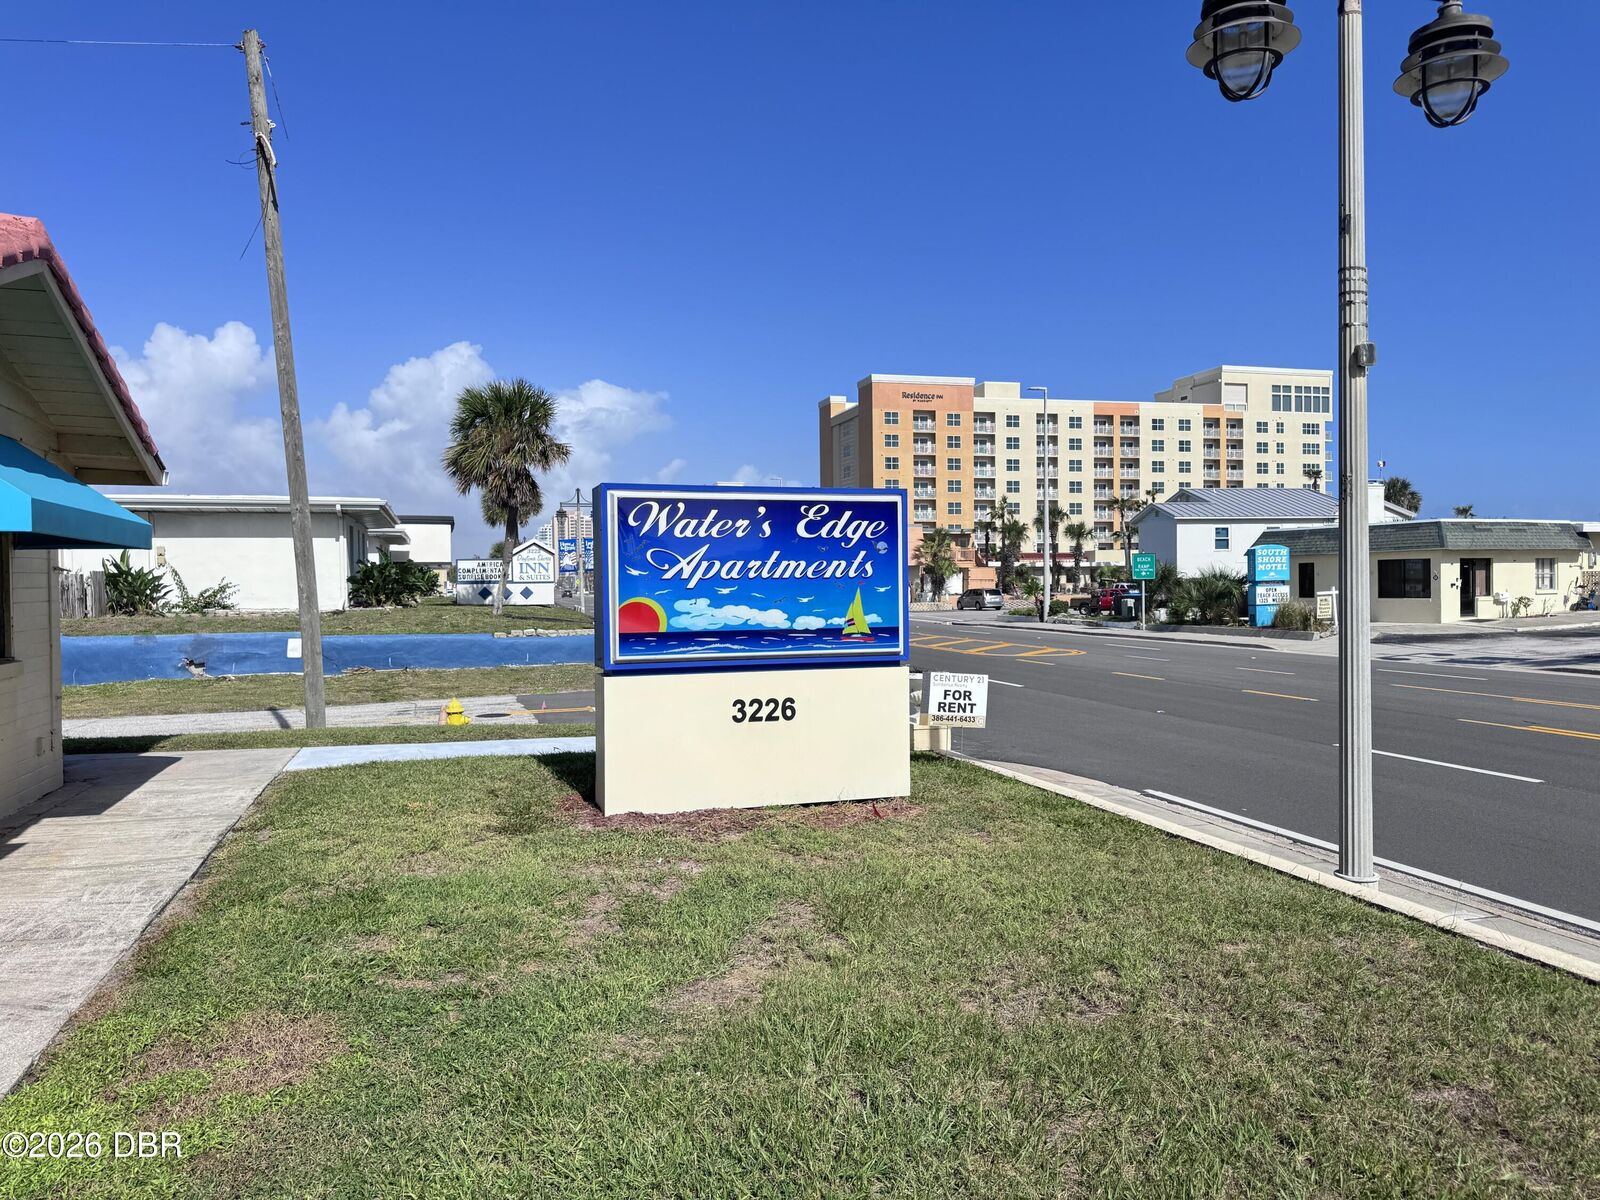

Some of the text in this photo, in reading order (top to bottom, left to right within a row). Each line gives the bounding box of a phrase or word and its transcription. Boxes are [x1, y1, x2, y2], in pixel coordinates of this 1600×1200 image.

[627, 501, 888, 548] Water's Edge
[519, 562, 550, 574] INN
[646, 544, 875, 589] Apartments
[933, 674, 985, 684] CENTURY 21
[943, 689, 972, 701] FOR
[732, 697, 797, 723] 3226
[937, 702, 977, 713] RENT
